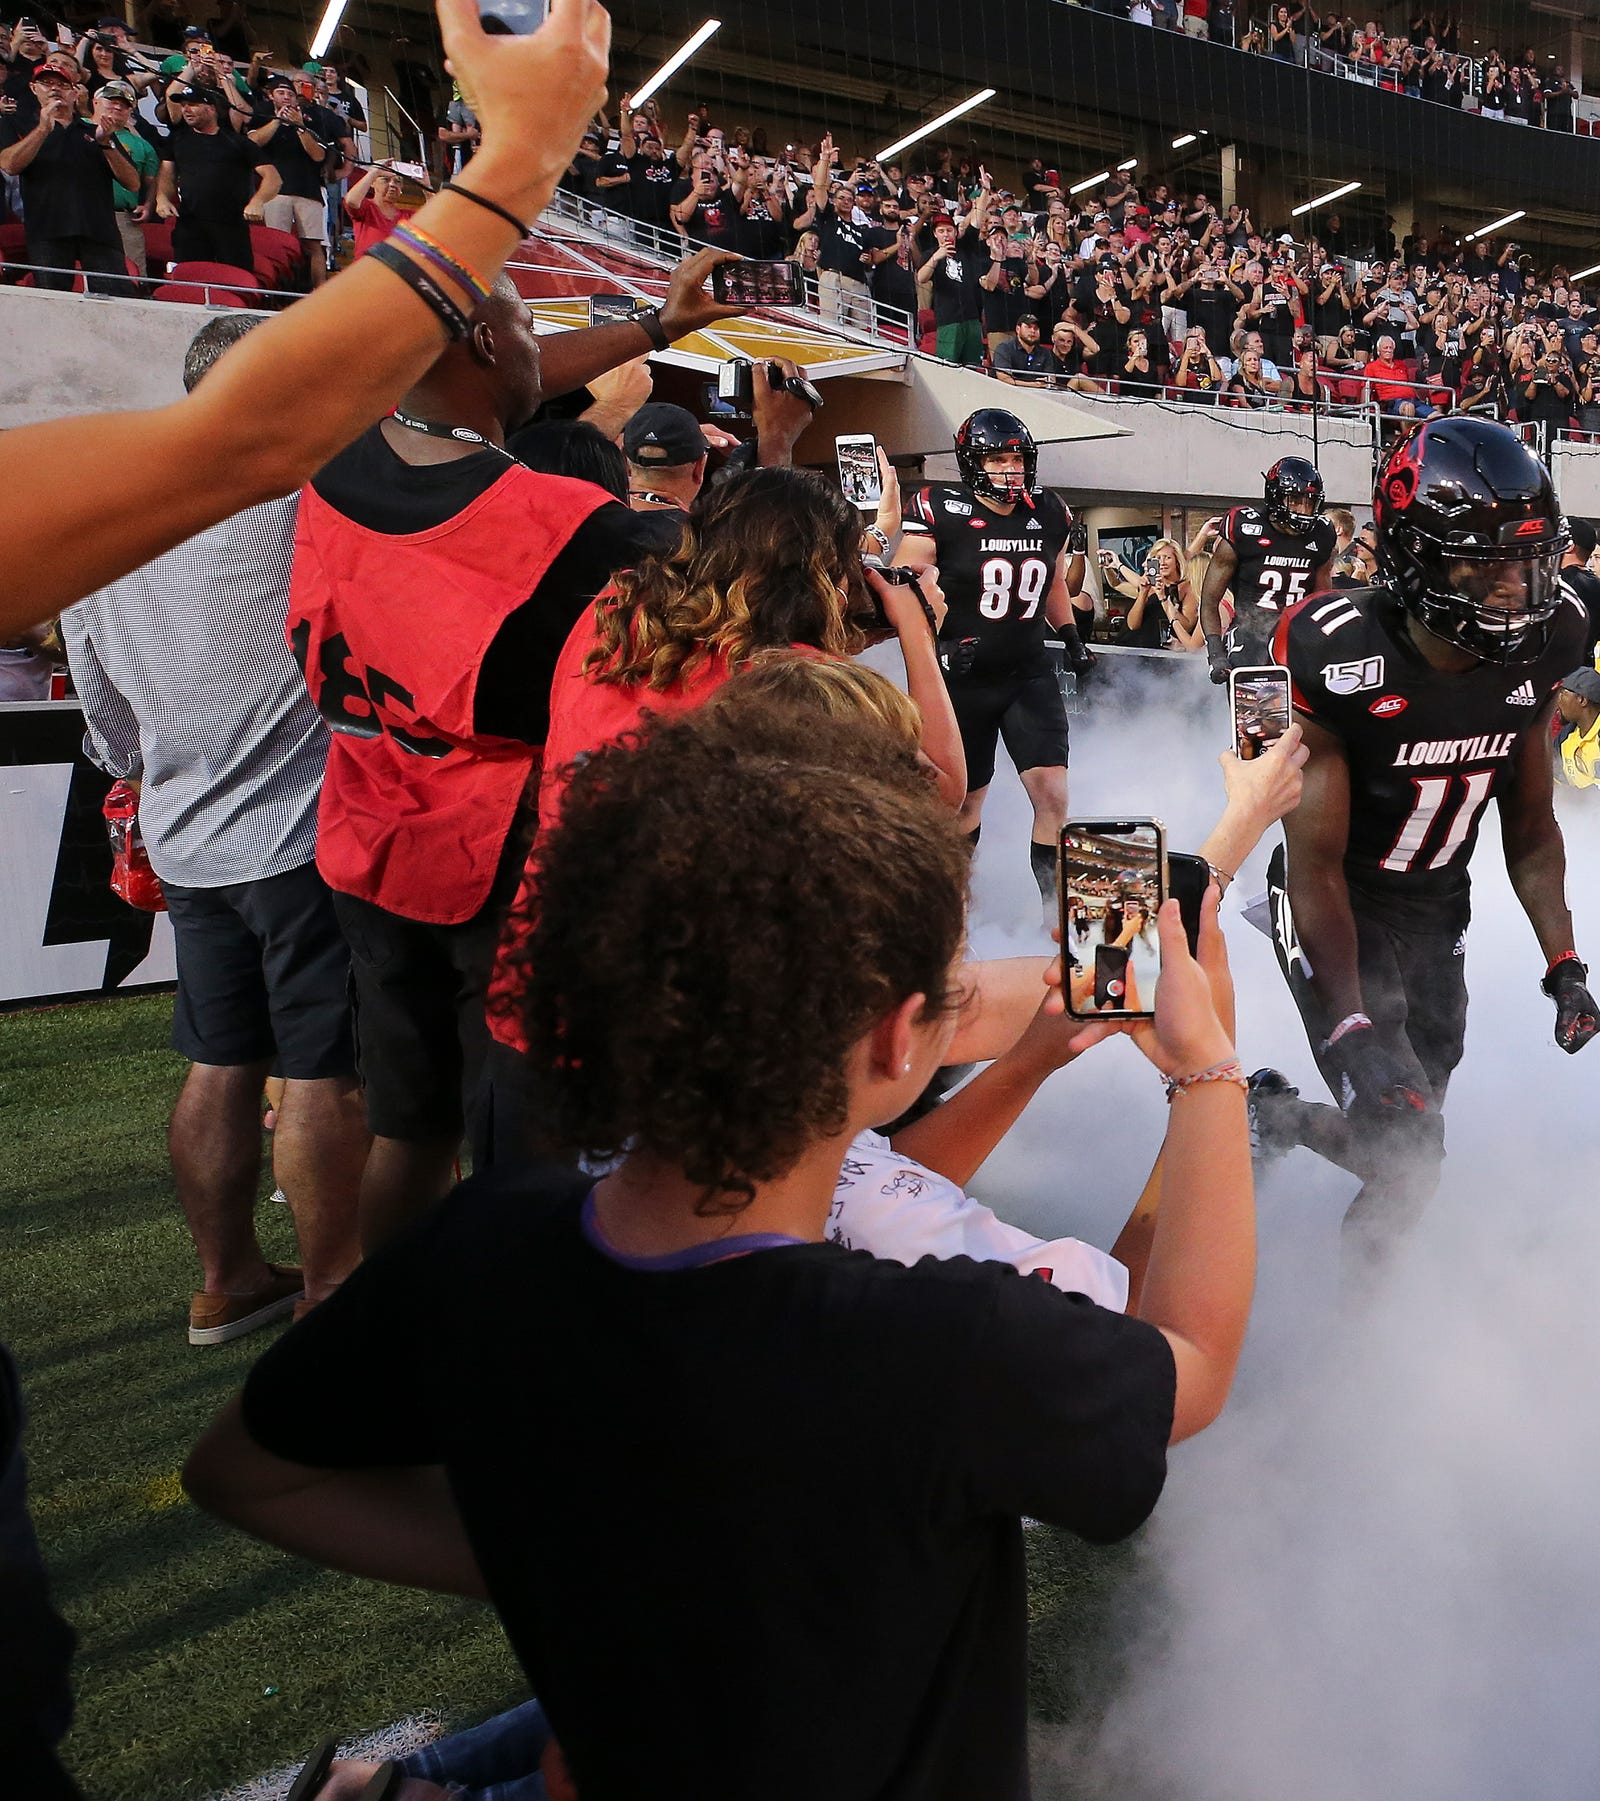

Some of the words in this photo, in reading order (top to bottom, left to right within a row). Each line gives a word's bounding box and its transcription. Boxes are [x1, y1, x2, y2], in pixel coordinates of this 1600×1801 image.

[979, 538, 1044, 552] LOUISVILLE
[1516, 519, 1545, 535] ACC
[1262, 555, 1312, 570] LOUISVILLE
[978, 556, 1049, 620] 89
[1256, 569, 1312, 610] 25
[1310, 597, 1362, 637] 11
[1320, 655, 1385, 694] 150
[1375, 697, 1404, 712] ACC
[1505, 694, 1537, 707] adidas
[1391, 731, 1518, 767] LOUISVILLE
[1378, 768, 1496, 874] 11
